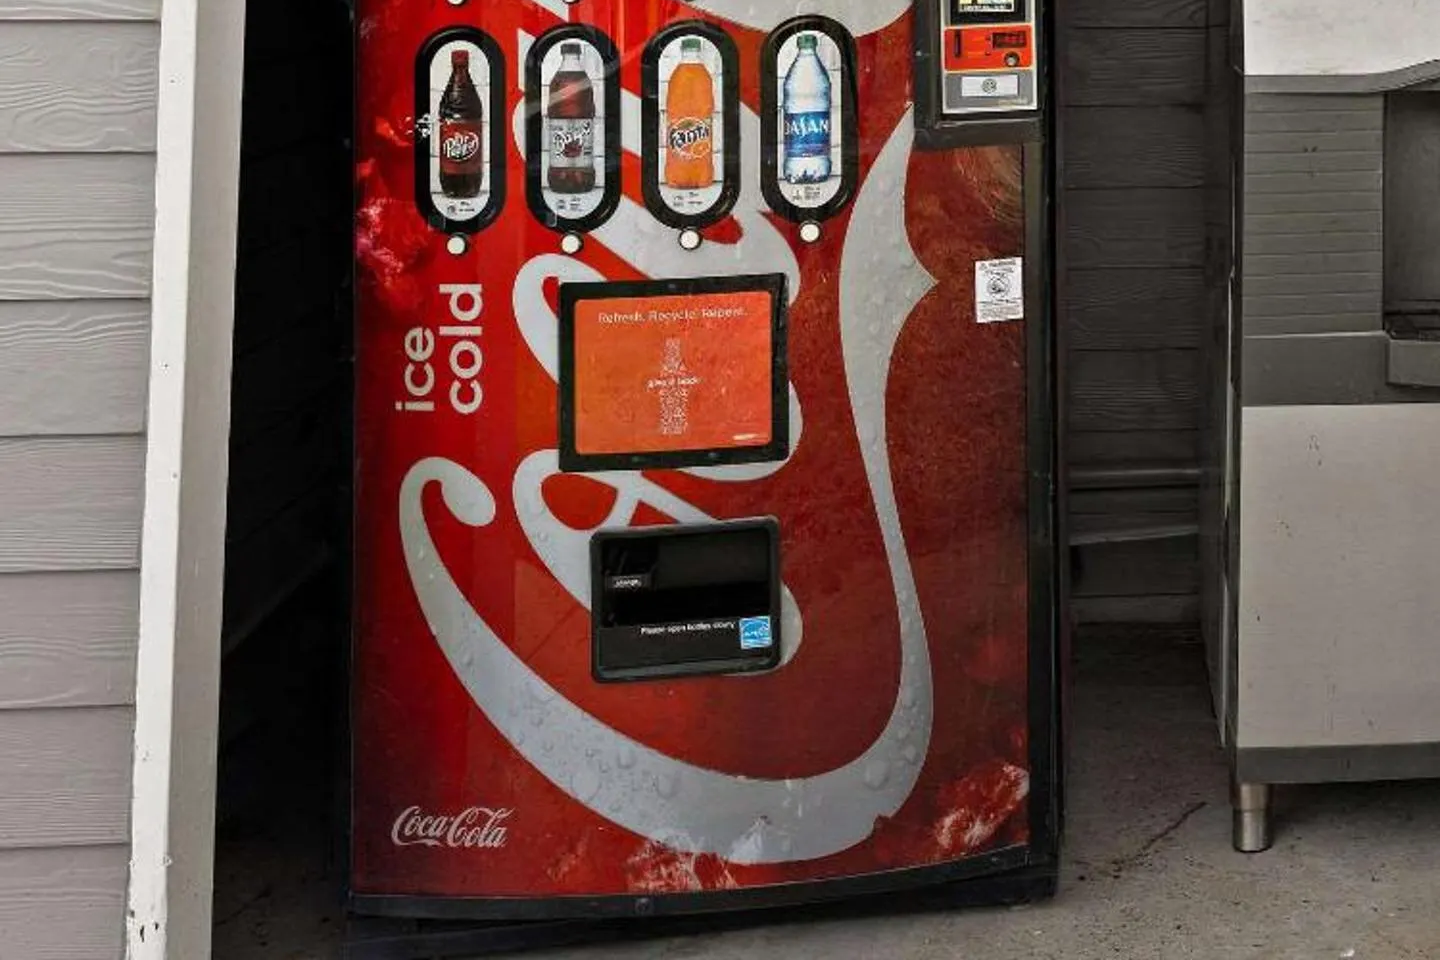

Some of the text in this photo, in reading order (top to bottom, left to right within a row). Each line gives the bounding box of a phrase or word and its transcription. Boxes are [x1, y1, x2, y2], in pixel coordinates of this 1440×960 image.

[395, 327, 435, 412] ice
[439, 283, 484, 415] cold
[391, 805, 515, 848] Coca-Cola
